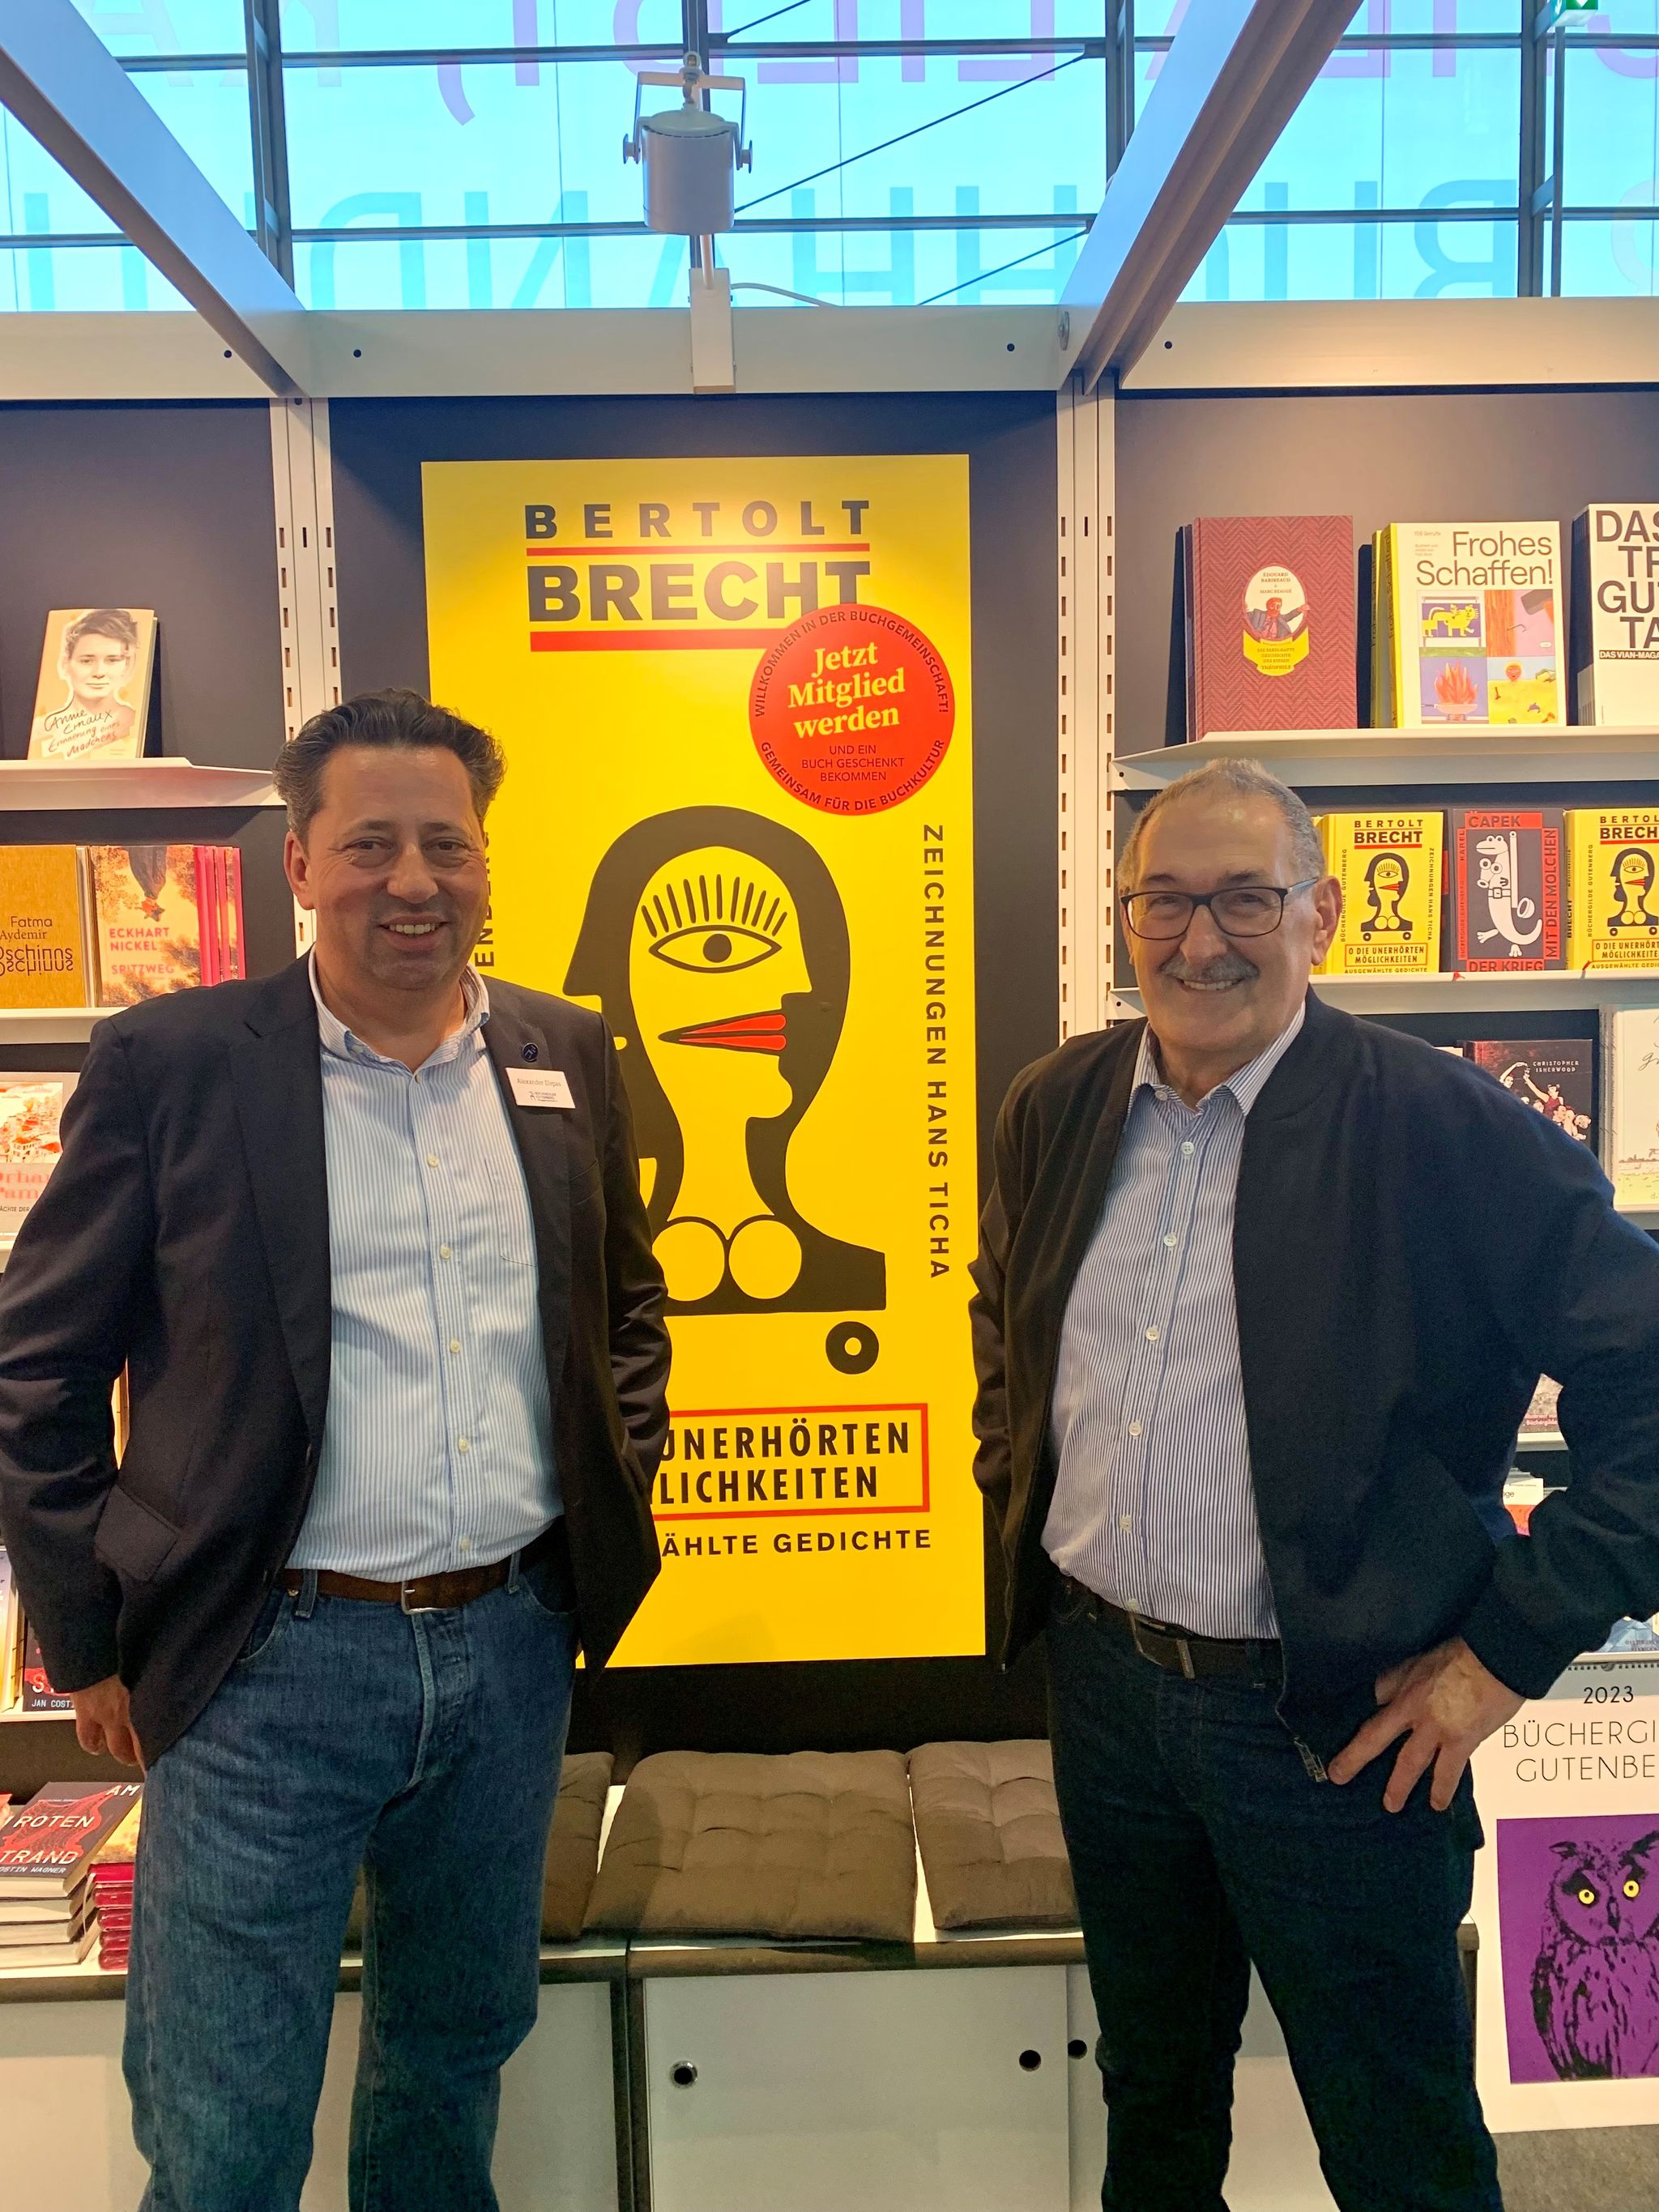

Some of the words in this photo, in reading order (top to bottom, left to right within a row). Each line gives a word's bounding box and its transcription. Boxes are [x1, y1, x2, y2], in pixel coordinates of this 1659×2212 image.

[525, 500, 869, 539] BERTOLT
[1596, 510, 1659, 543] DA
[1453, 531, 1552, 556] Frohes
[1416, 559, 1553, 586] Schaffen!
[527, 560, 871, 622] BRECHT
[1597, 580, 1659, 613] GU
[755, 629, 801, 717] WILLKOMMEN
[802, 619, 817, 635] IN
[820, 612, 846, 626] DER
[851, 611, 949, 713] BUCHGEMEINSCHAFT!
[811, 641, 878, 678] Jetzt
[787, 667, 906, 709] Mitglied
[45, 710, 87, 731] Annie
[793, 705, 900, 739] werden
[830, 745, 855, 755] UND
[858, 745, 876, 754] EIN
[761, 742, 822, 804] GEMEINSAM
[825, 796, 850, 811] FÜR
[855, 798, 876, 811] DIE
[880, 739, 945, 806] BUCHKULTUR
[802, 759, 833, 769] BUCH
[836, 757, 905, 768] GESCHENKT
[820, 771, 886, 782] BEKOMMEN
[1354, 820, 1423, 828] BERTOLT
[1354, 831, 1423, 844] BRECHT
[1544, 829, 1557, 896] MOLCHEN
[11, 916, 53, 927] Fatma
[1546, 898, 1557, 928] DEN
[109, 927, 170, 939] ECKHART
[923, 825, 946, 1064] ZEICHNUNGEN
[1546, 932, 1557, 957] MIT
[110, 941, 157, 952] NICKEL
[1349, 948, 1354, 956] O
[1357, 947, 1369, 955] DIE
[1372, 945, 1424, 955] UNERHÖRTEN
[1602, 950, 1658, 959] MÖGLICHKEITE
[1604, 942, 1616, 950] DIE
[111, 964, 175, 975] SPITZWEG
[1355, 955, 1417, 964] MÖGLICHKEITEN
[1469, 961, 1498, 971] DER
[1502, 961, 1543, 971] KRIEG
[927, 1081, 948, 1168] HANS
[929, 1182, 950, 1278] TICHA
[663, 1417, 909, 1461] UNERHÖRTEN
[659, 1466, 877, 1504] LICHKEITEN
[662, 1532, 758, 1557] ÄHLTE
[774, 1529, 931, 1554] GEDICHTE
[32, 1699, 46, 1707] JAN
[1584, 1686, 1634, 1704] 2023
[1503, 1720, 1656, 1748] BÜCHERGI
[1516, 1754, 1655, 1782] GUTENBE
[105, 1784, 141, 1796] AM
[13, 1815, 95, 1828] ROTEN
